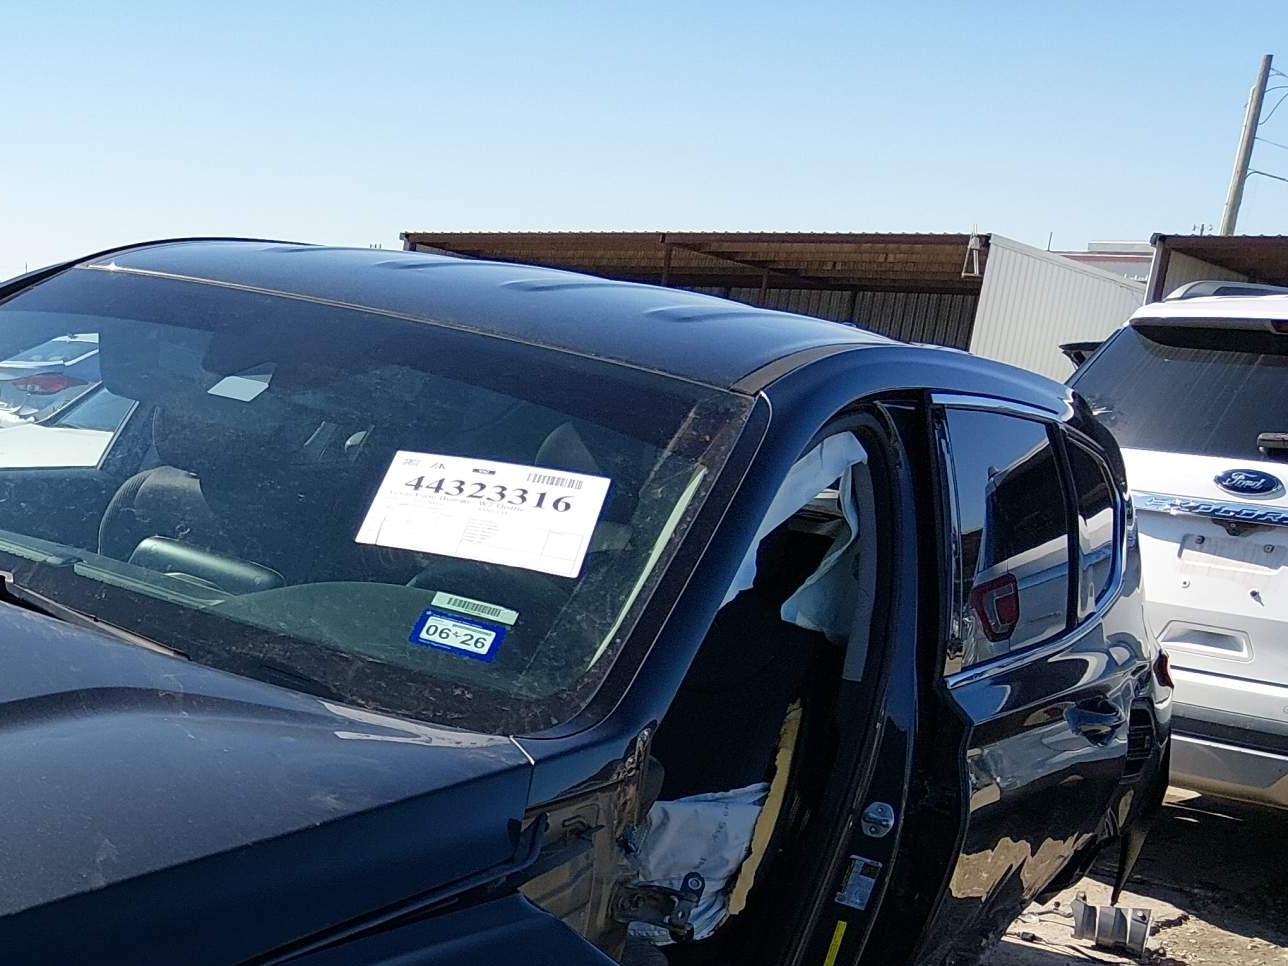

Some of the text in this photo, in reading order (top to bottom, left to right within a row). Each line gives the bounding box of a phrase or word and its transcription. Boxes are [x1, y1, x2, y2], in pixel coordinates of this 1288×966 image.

[404, 475, 575, 513] 44323316
[1223, 472, 1266, 489] Ford
[1144, 496, 1288, 524] EXPLOR
